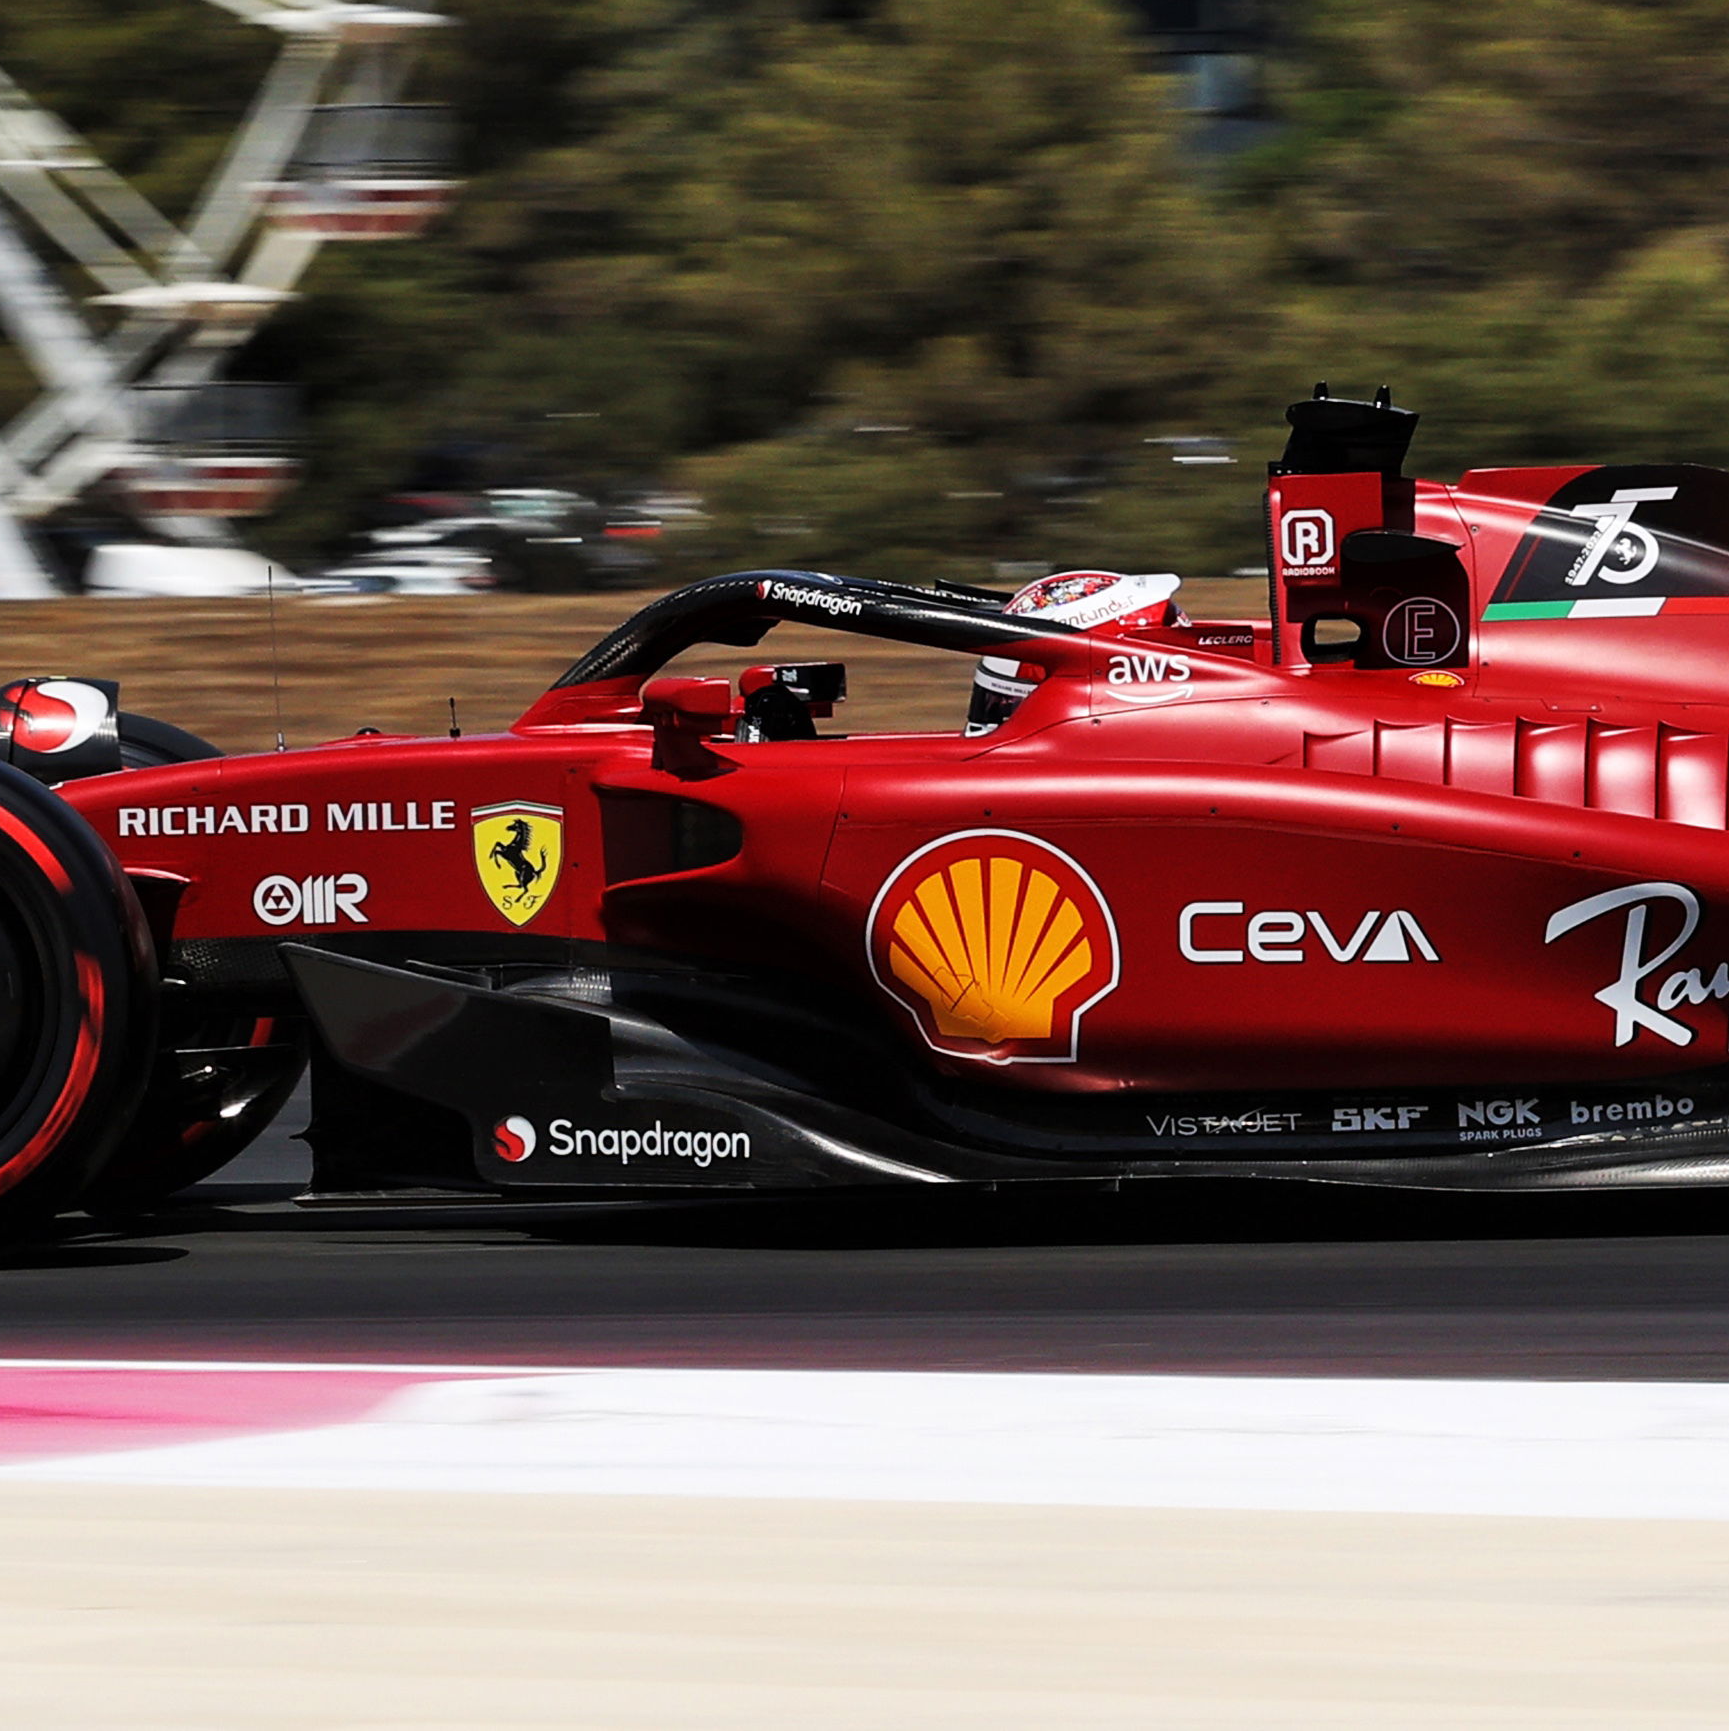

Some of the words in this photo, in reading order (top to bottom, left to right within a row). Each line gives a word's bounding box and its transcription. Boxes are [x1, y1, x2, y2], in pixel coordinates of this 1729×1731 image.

[771, 582, 862, 616] Snapdragon
[1198, 635, 1253, 645] LECLERC
[1107, 654, 1191, 685] aws
[119, 803, 309, 837] RICHARD
[328, 801, 457, 833] MILLE
[1332, 1105, 1429, 1132] SKF
[1457, 1097, 1541, 1128] NGK
[1570, 1094, 1695, 1125] brembo
[549, 1119, 751, 1168] Snapdragon
[1459, 1130, 1499, 1142] SPARK
[1502, 1127, 1542, 1139] PLUGS
